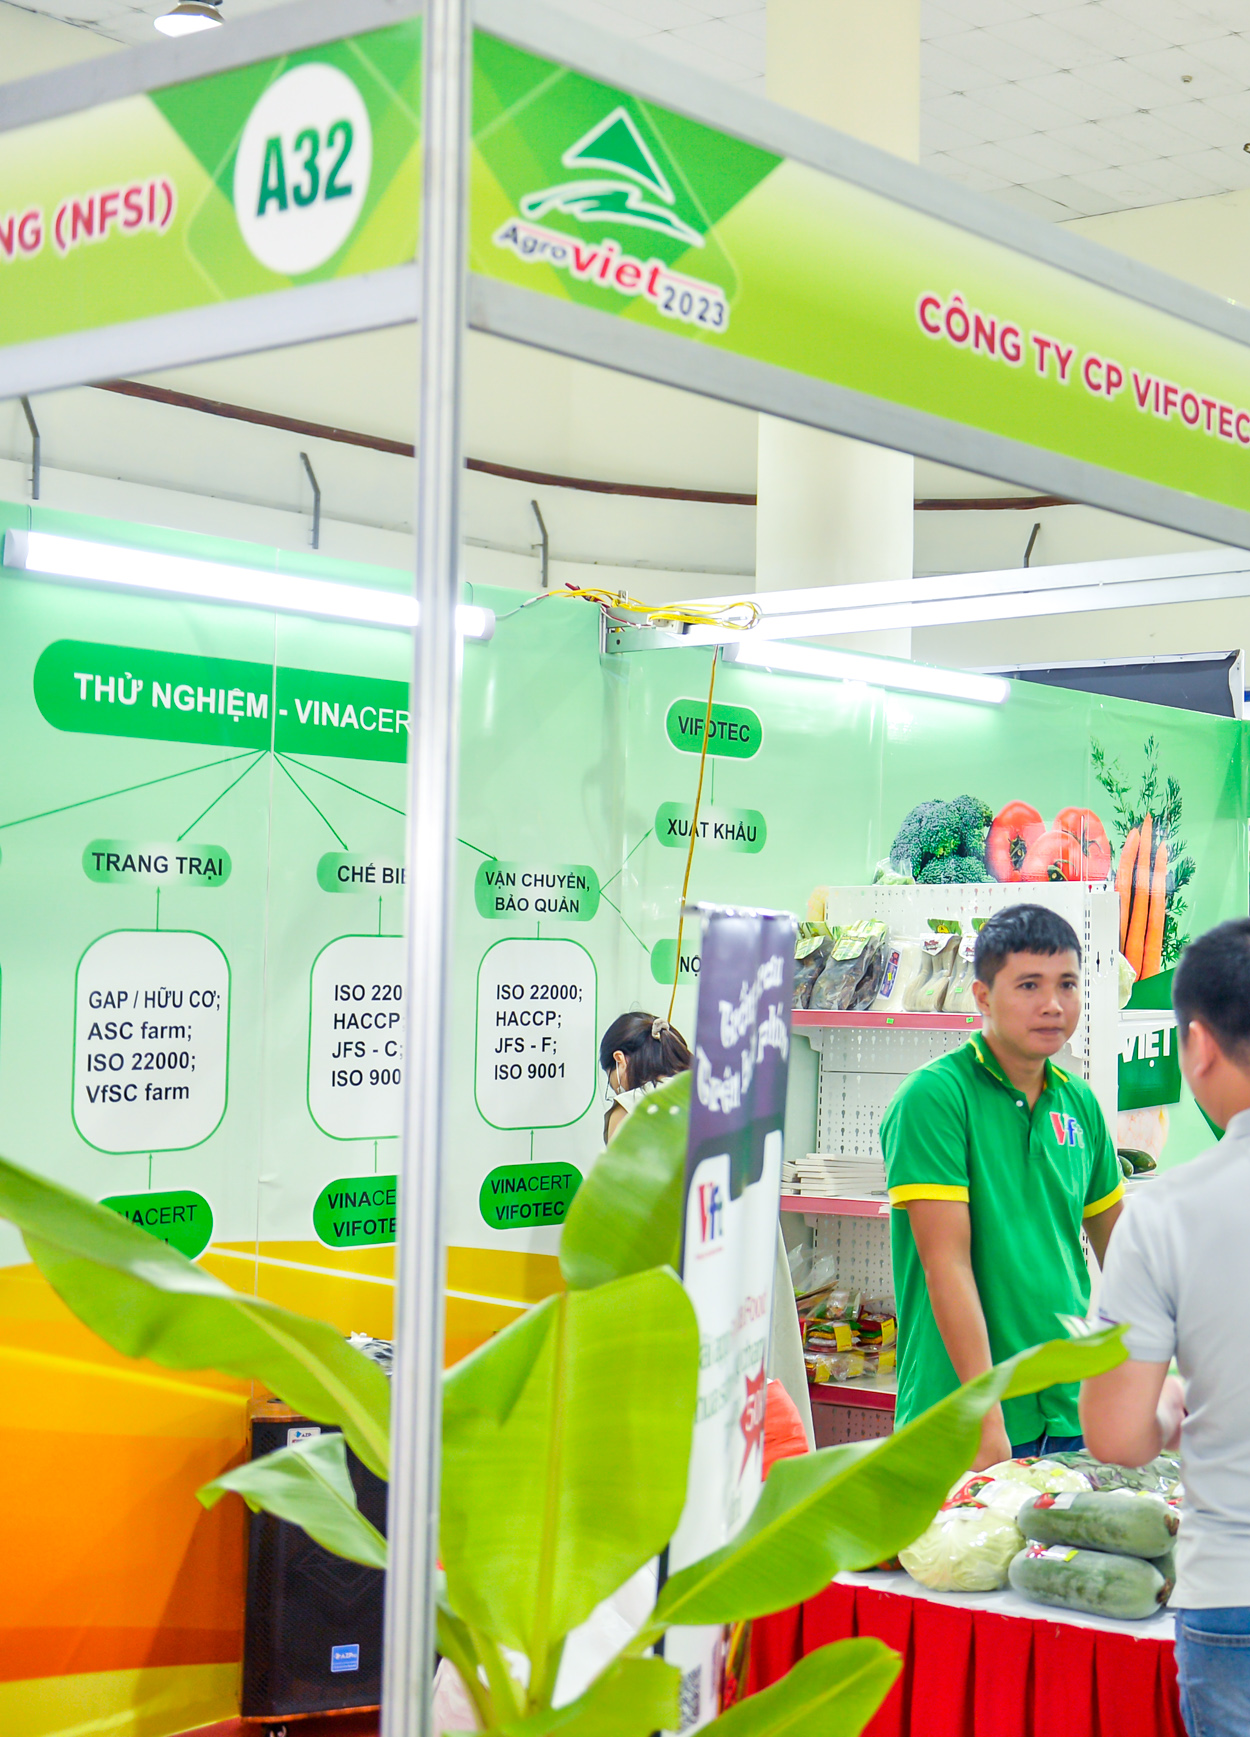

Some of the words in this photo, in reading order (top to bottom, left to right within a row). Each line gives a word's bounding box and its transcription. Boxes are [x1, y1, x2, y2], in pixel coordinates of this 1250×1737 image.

[254, 119, 355, 219] A32
[55, 179, 174, 251] (NFSI)
[662, 284, 726, 328] 2023
[919, 295, 1022, 363] CÔNG
[1032, 335, 1074, 380] TY
[1084, 357, 1123, 396] CP
[1132, 372, 1250, 444] VIFOTEC
[73, 670, 144, 706] THỬ
[151, 680, 270, 723] NGHIỆM
[677, 715, 751, 743] VIFOTEC
[91, 852, 169, 874] TRANG
[175, 856, 223, 880] TRẠI
[485, 870, 516, 890] VẬN
[495, 893, 530, 912] BẢO
[534, 895, 580, 914] QUẢN
[88, 990, 129, 1010] GAP
[143, 986, 184, 1009] HỮU
[188, 989, 221, 1011] CƠ;
[334, 984, 366, 1002] ISO
[496, 984, 525, 1001] ISO
[529, 983, 583, 1003] 22000;
[495, 1010, 562, 1028] HACCP;
[87, 1021, 134, 1041] ASC
[140, 1021, 193, 1043] farm;
[332, 1040, 366, 1059] JFS
[494, 1037, 525, 1054] JFS
[541, 1036, 558, 1055] F;
[86, 1053, 125, 1073] ISO
[130, 1051, 196, 1073] 22000;
[494, 1064, 523, 1081] ISO
[527, 1062, 566, 1080] 9001
[331, 1069, 364, 1088] ISO
[85, 1083, 138, 1104] VfSC
[144, 1082, 190, 1101] farm
[490, 1173, 573, 1195] VINACERT
[495, 1201, 565, 1221] VIFOTEC
